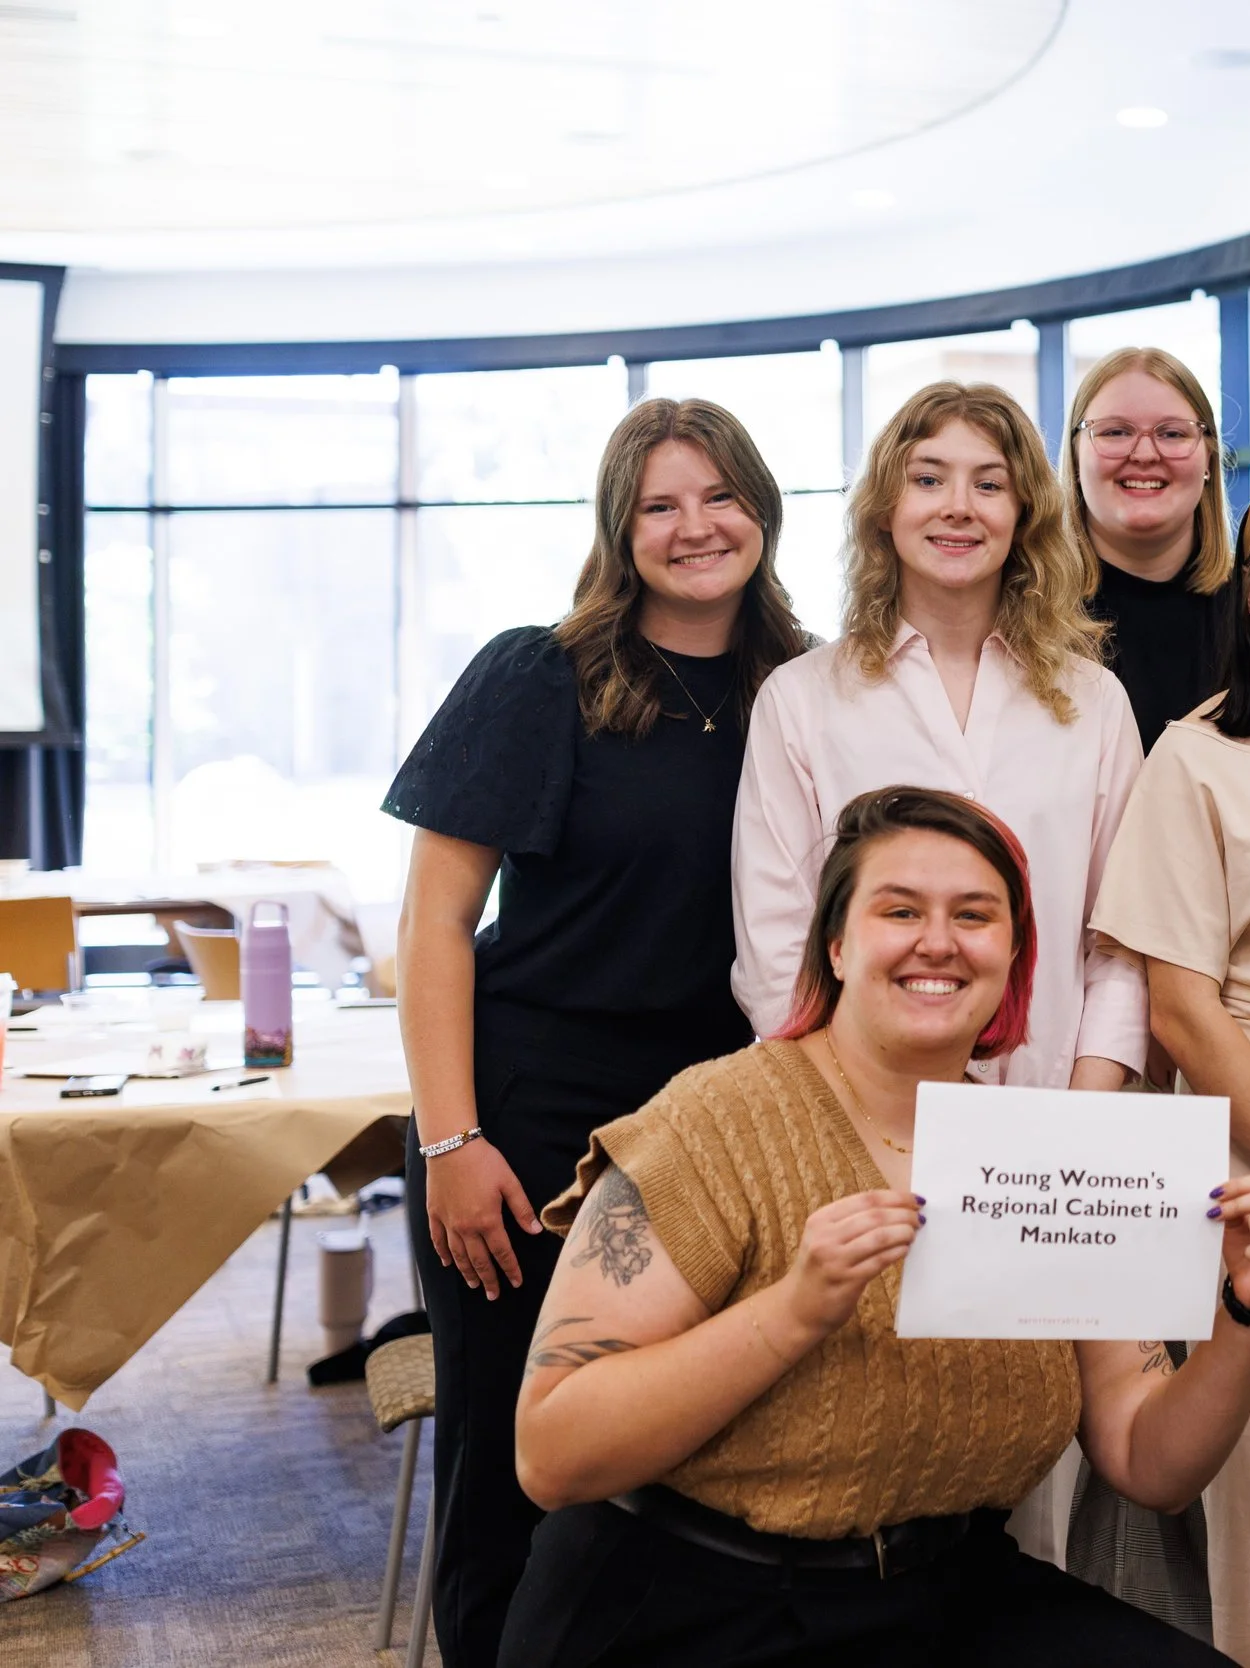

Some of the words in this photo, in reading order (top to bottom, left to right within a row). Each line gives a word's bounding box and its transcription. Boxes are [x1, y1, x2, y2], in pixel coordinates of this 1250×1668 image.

[980, 1167, 1052, 1192] Young
[1059, 1169, 1166, 1190] Women's
[961, 1195, 1058, 1219] Regional
[1065, 1198, 1153, 1218] Cabinet
[1159, 1199, 1179, 1219] in
[1020, 1225, 1118, 1246] Mankato
